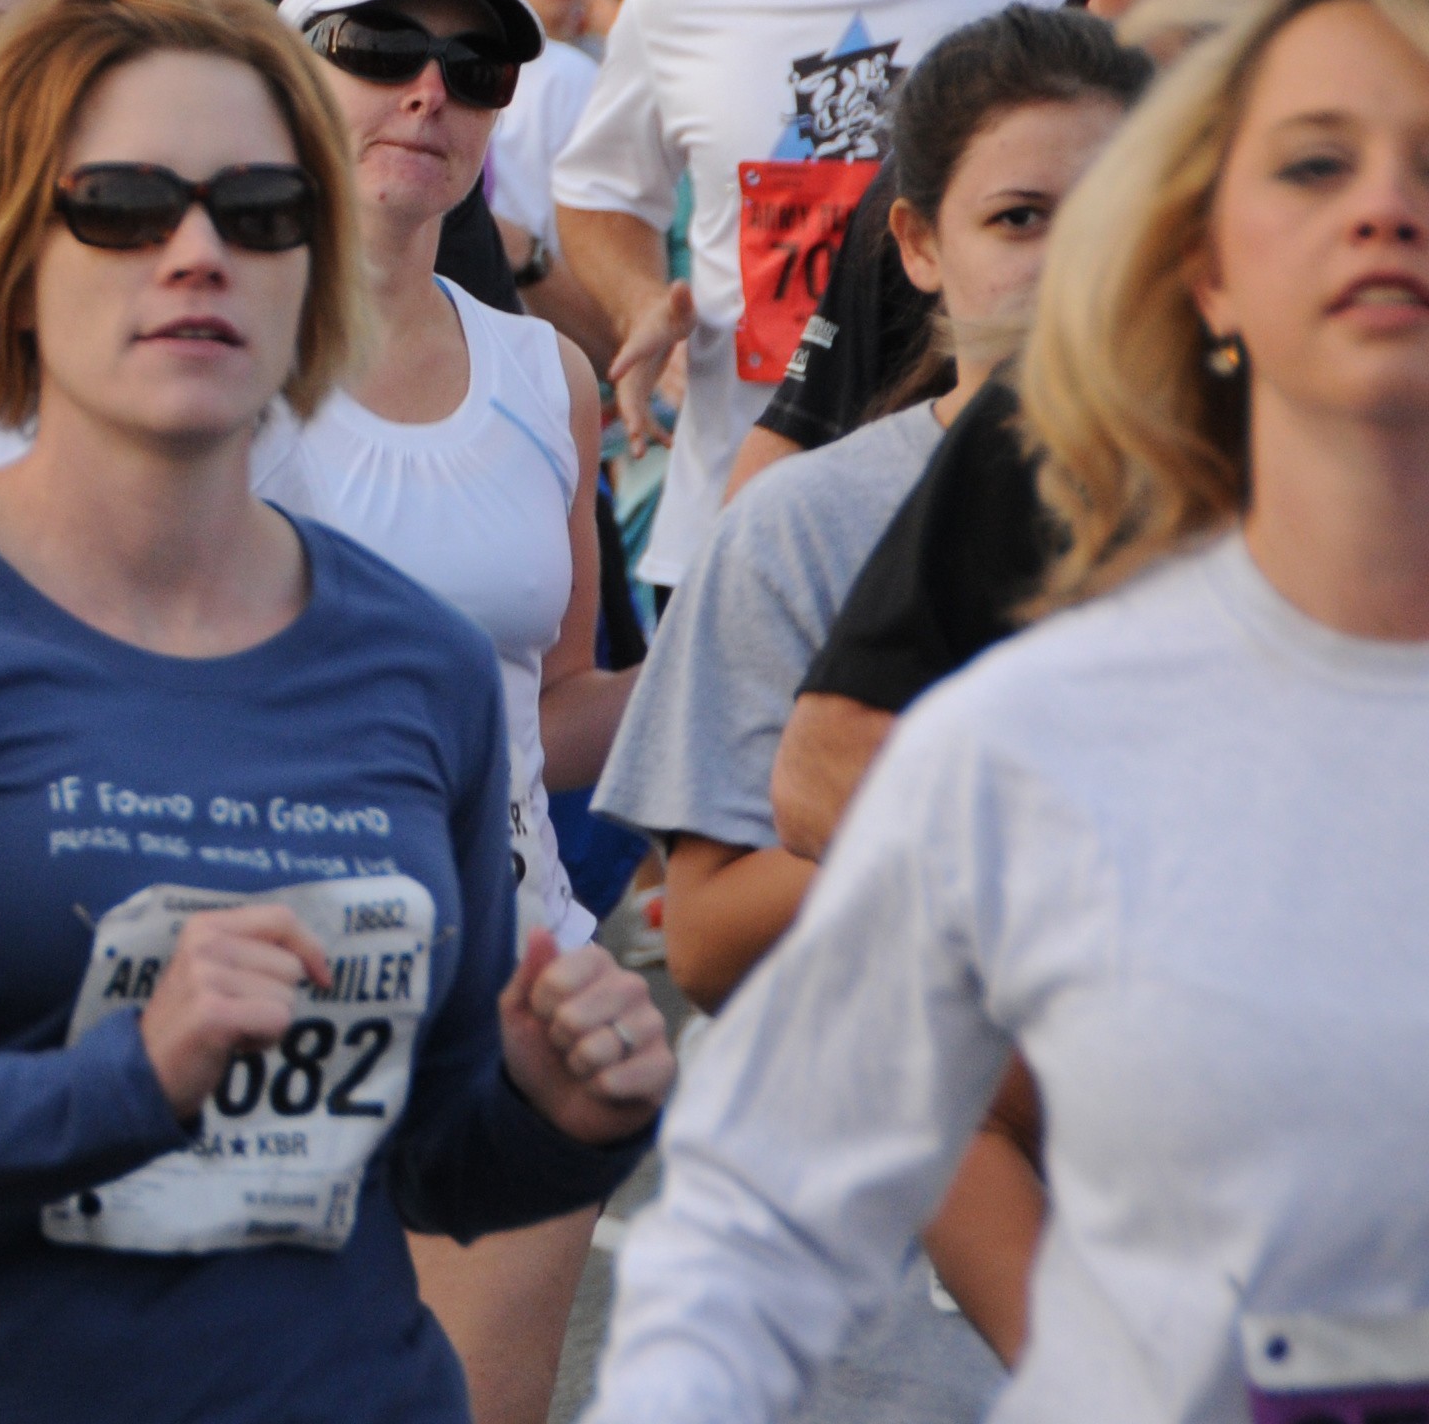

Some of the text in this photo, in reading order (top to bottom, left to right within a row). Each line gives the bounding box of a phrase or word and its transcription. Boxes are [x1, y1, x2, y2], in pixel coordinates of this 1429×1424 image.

[769, 240, 833, 300] 70
[103, 953, 415, 1002] AR -MILER
[214, 1016, 393, 1117] 682
